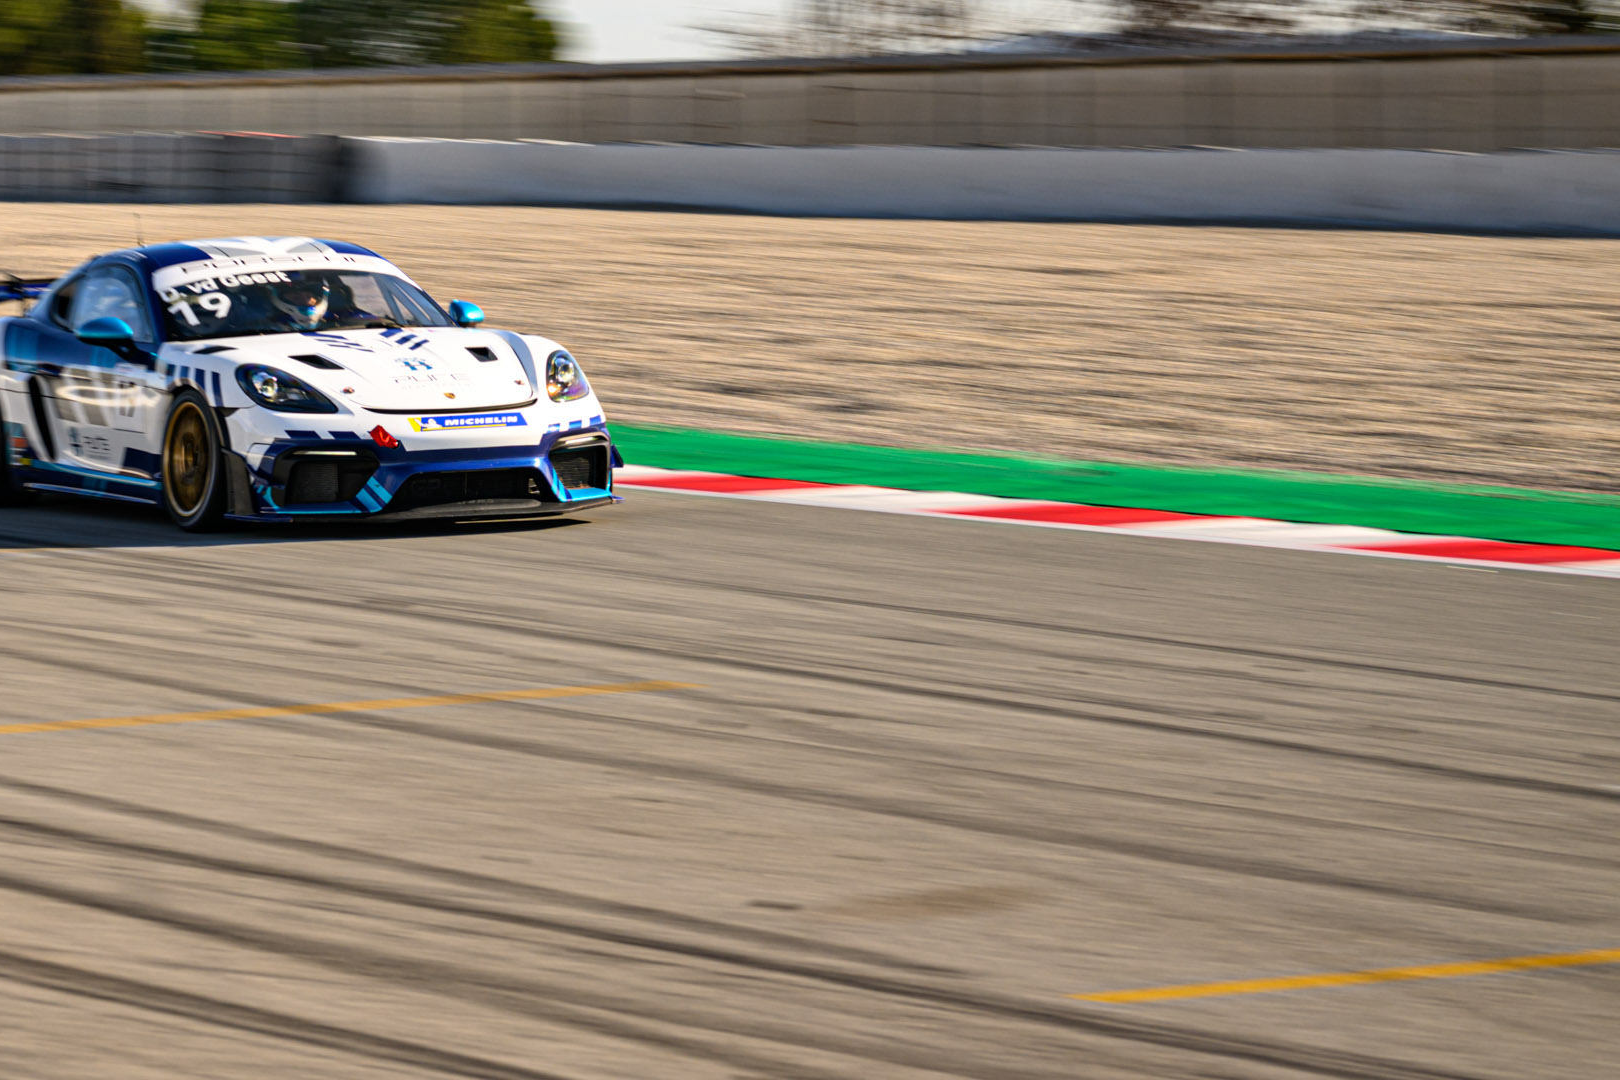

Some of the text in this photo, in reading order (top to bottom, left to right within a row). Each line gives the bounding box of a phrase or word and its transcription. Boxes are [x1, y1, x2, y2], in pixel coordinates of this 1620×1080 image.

[186, 277, 220, 294] vd
[167, 292, 232, 327] 19
[444, 415, 518, 427] MICHELIN
